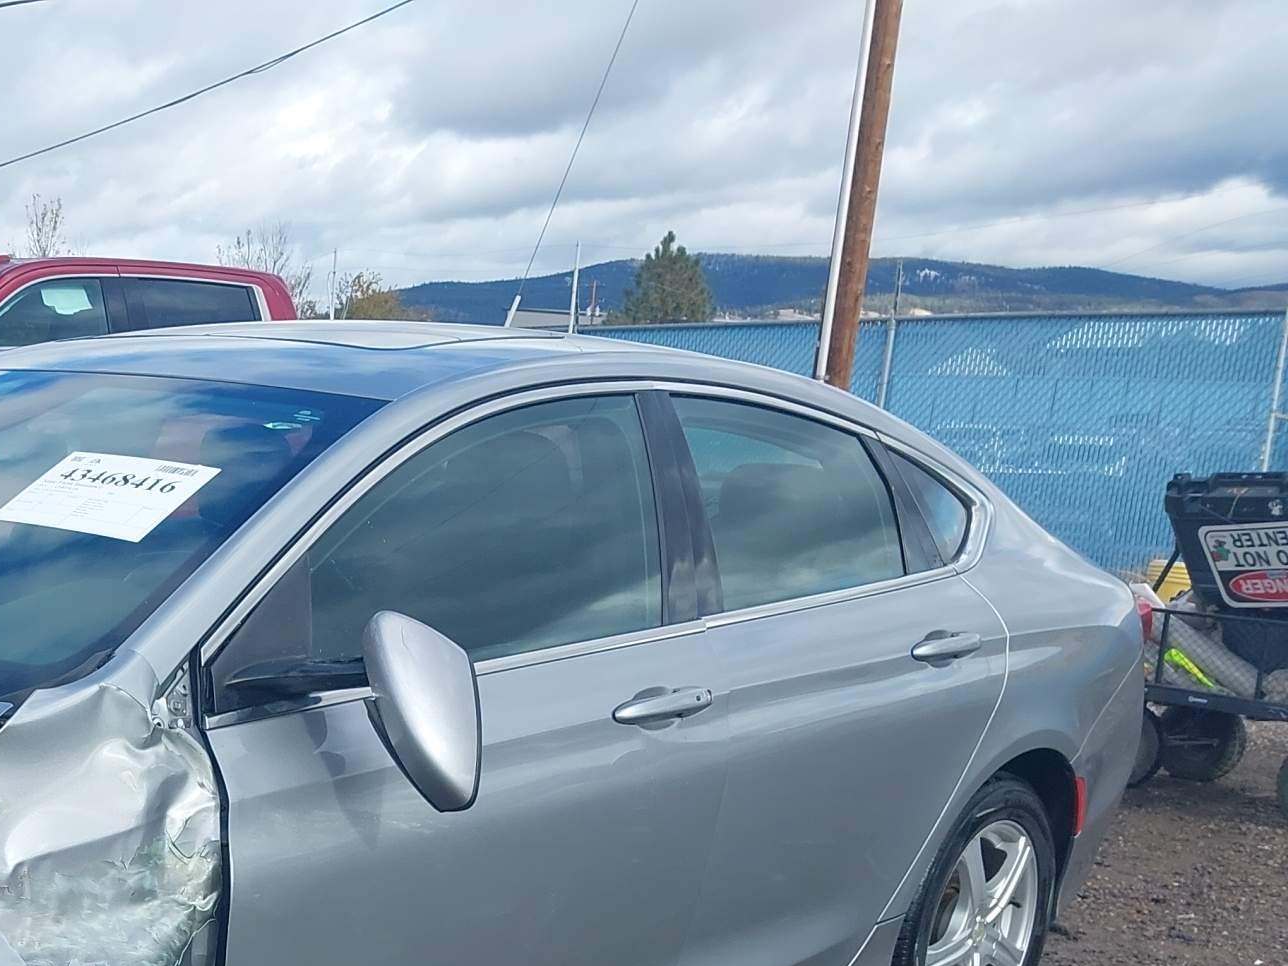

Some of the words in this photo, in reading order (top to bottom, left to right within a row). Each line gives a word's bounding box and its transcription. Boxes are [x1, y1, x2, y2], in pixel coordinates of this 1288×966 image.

[60, 467, 183, 494] 43468416
[1231, 531, 1288, 549] ENTER
[1233, 551, 1271, 567] NOT
[1239, 578, 1288, 594] NGER
